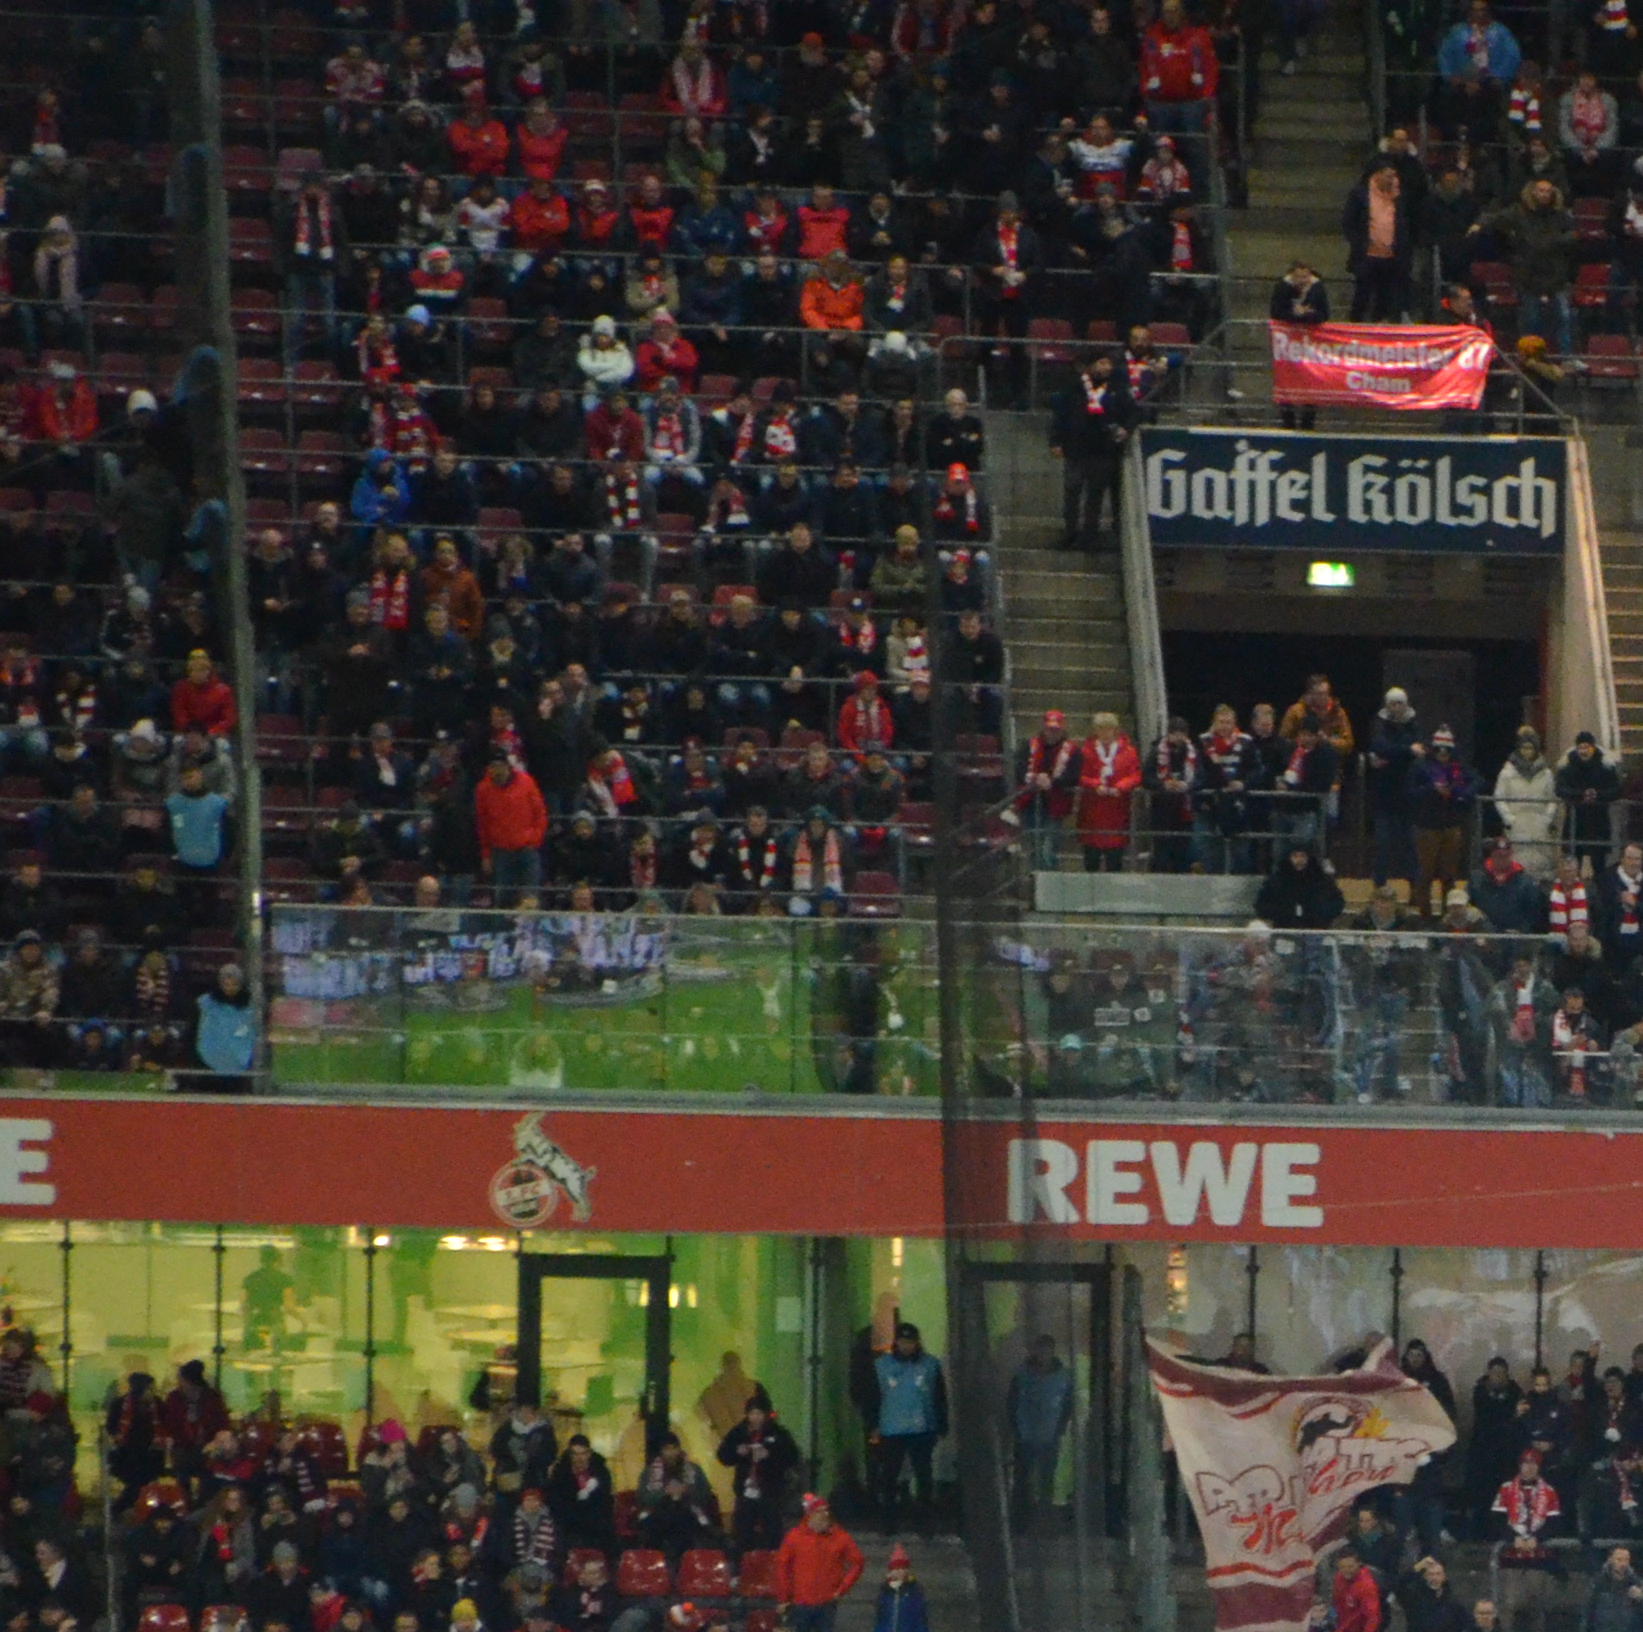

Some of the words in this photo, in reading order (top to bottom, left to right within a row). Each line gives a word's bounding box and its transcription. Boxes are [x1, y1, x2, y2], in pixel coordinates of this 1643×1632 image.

[1273, 331, 1453, 370] Rekordmeister
[1346, 370, 1412, 394] Cham
[1147, 440, 1336, 527] Gaffel
[1347, 454, 1556, 539] Kölsch
[1008, 1138, 1323, 1228] REWE
